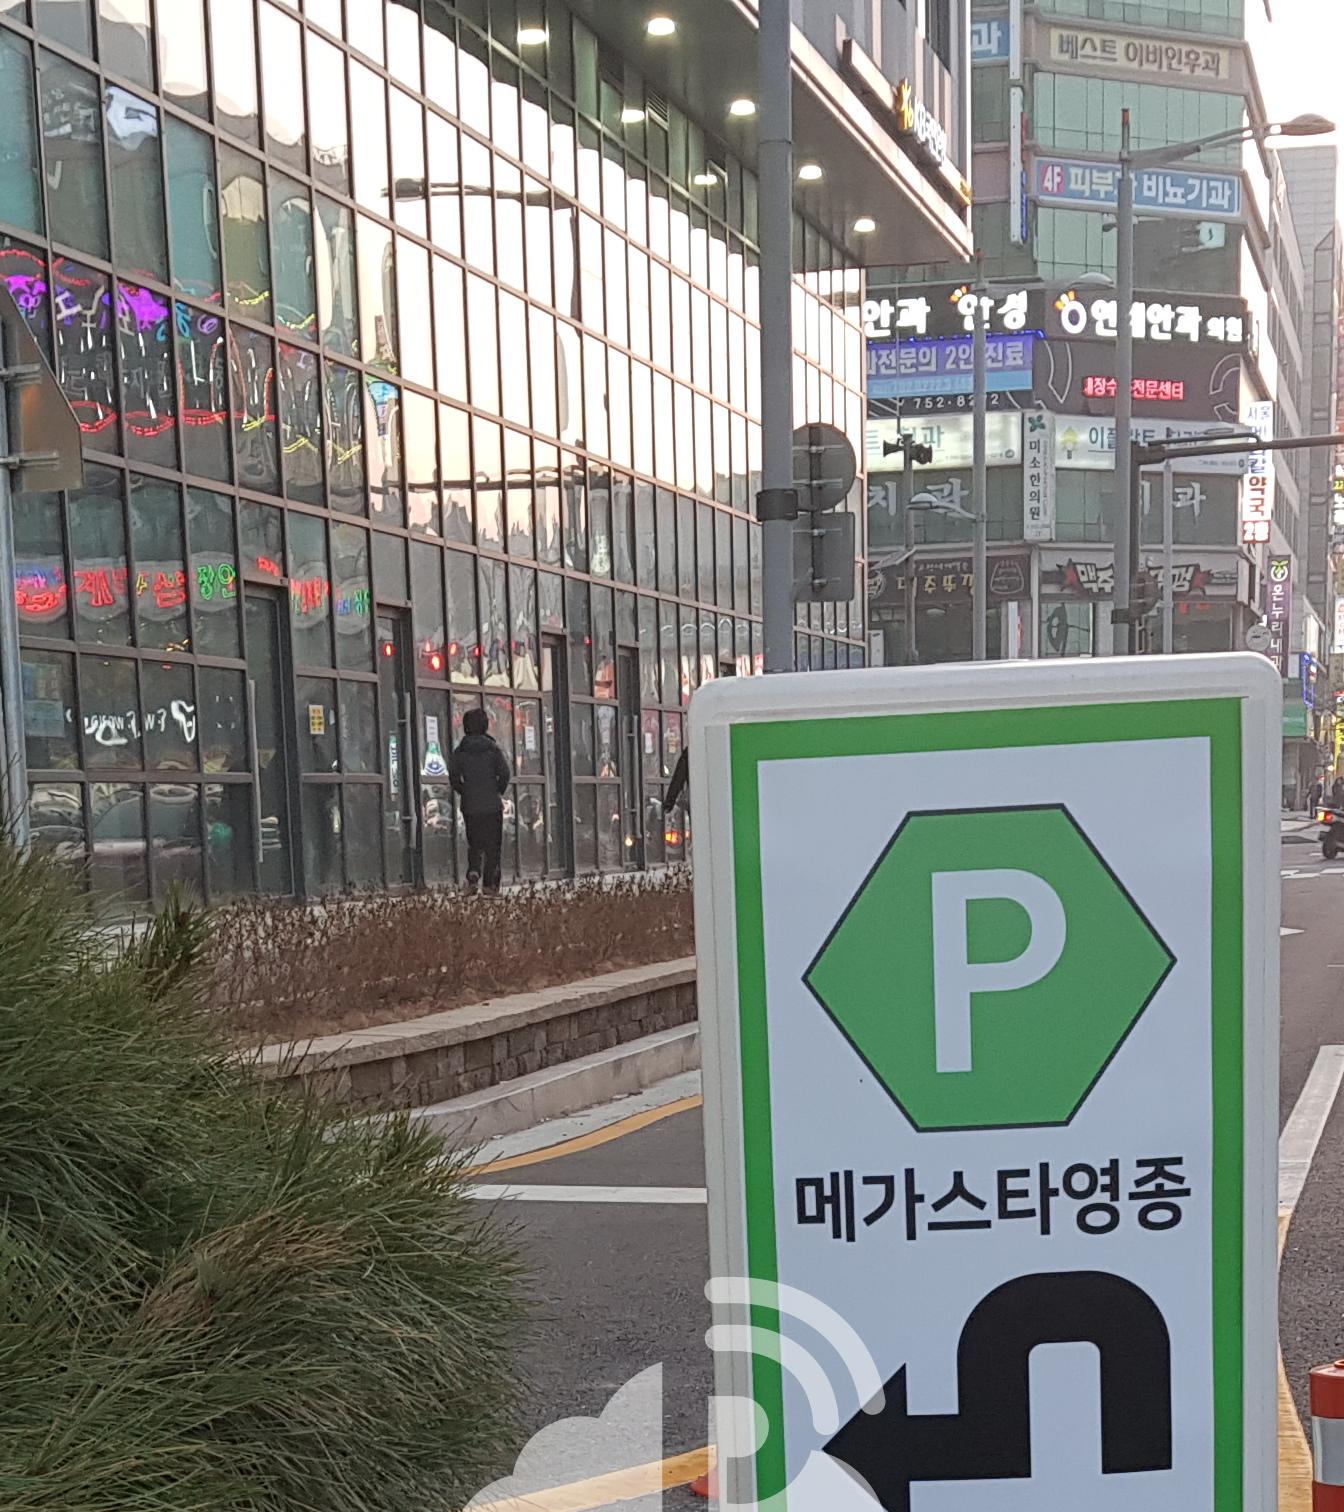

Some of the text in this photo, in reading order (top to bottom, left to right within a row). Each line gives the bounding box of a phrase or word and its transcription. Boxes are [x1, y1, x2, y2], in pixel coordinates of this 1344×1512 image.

[1058, 33, 1117, 63] 베스트
[1042, 165, 1064, 193] 4F
[1143, 173, 1232, 209] 비뇨기과
[1249, 476, 1268, 517] 약국
[931, 868, 1067, 1073] P
[795, 1156, 1192, 1242] 메가스타영종
